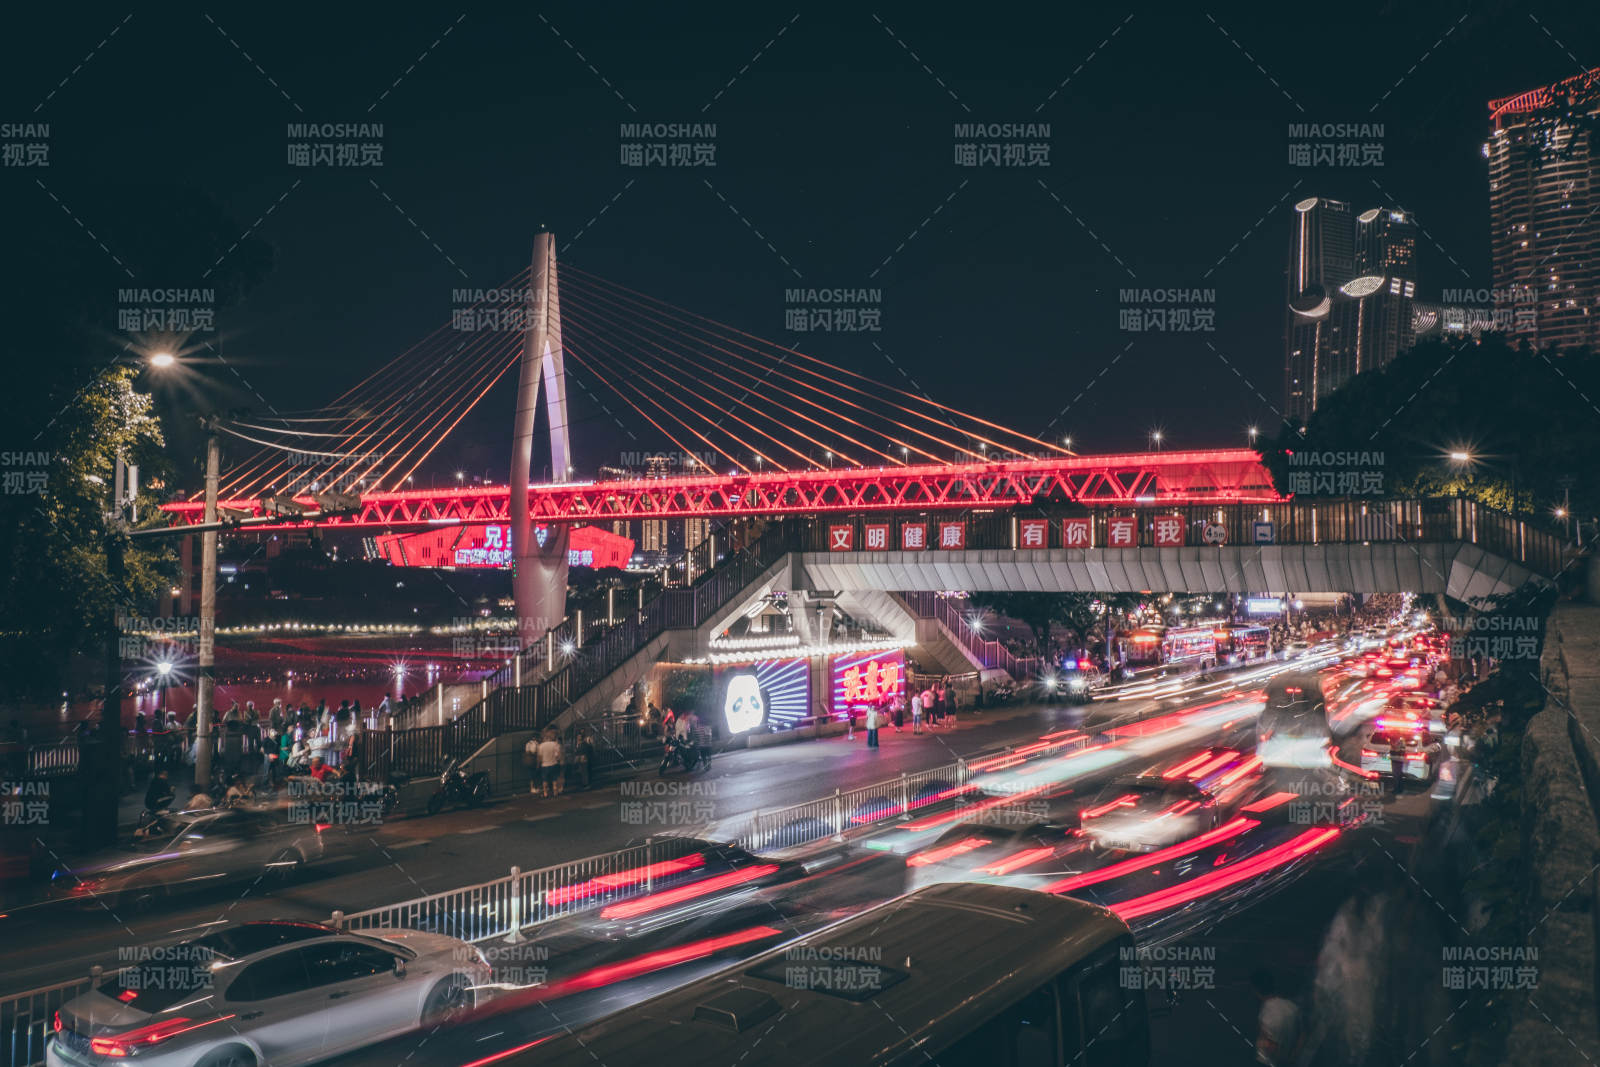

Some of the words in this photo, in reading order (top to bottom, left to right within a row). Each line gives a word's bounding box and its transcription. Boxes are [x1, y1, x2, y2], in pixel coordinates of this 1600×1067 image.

[833, 526, 961, 548] 文明健康
[1023, 520, 1181, 546] 有你有我
